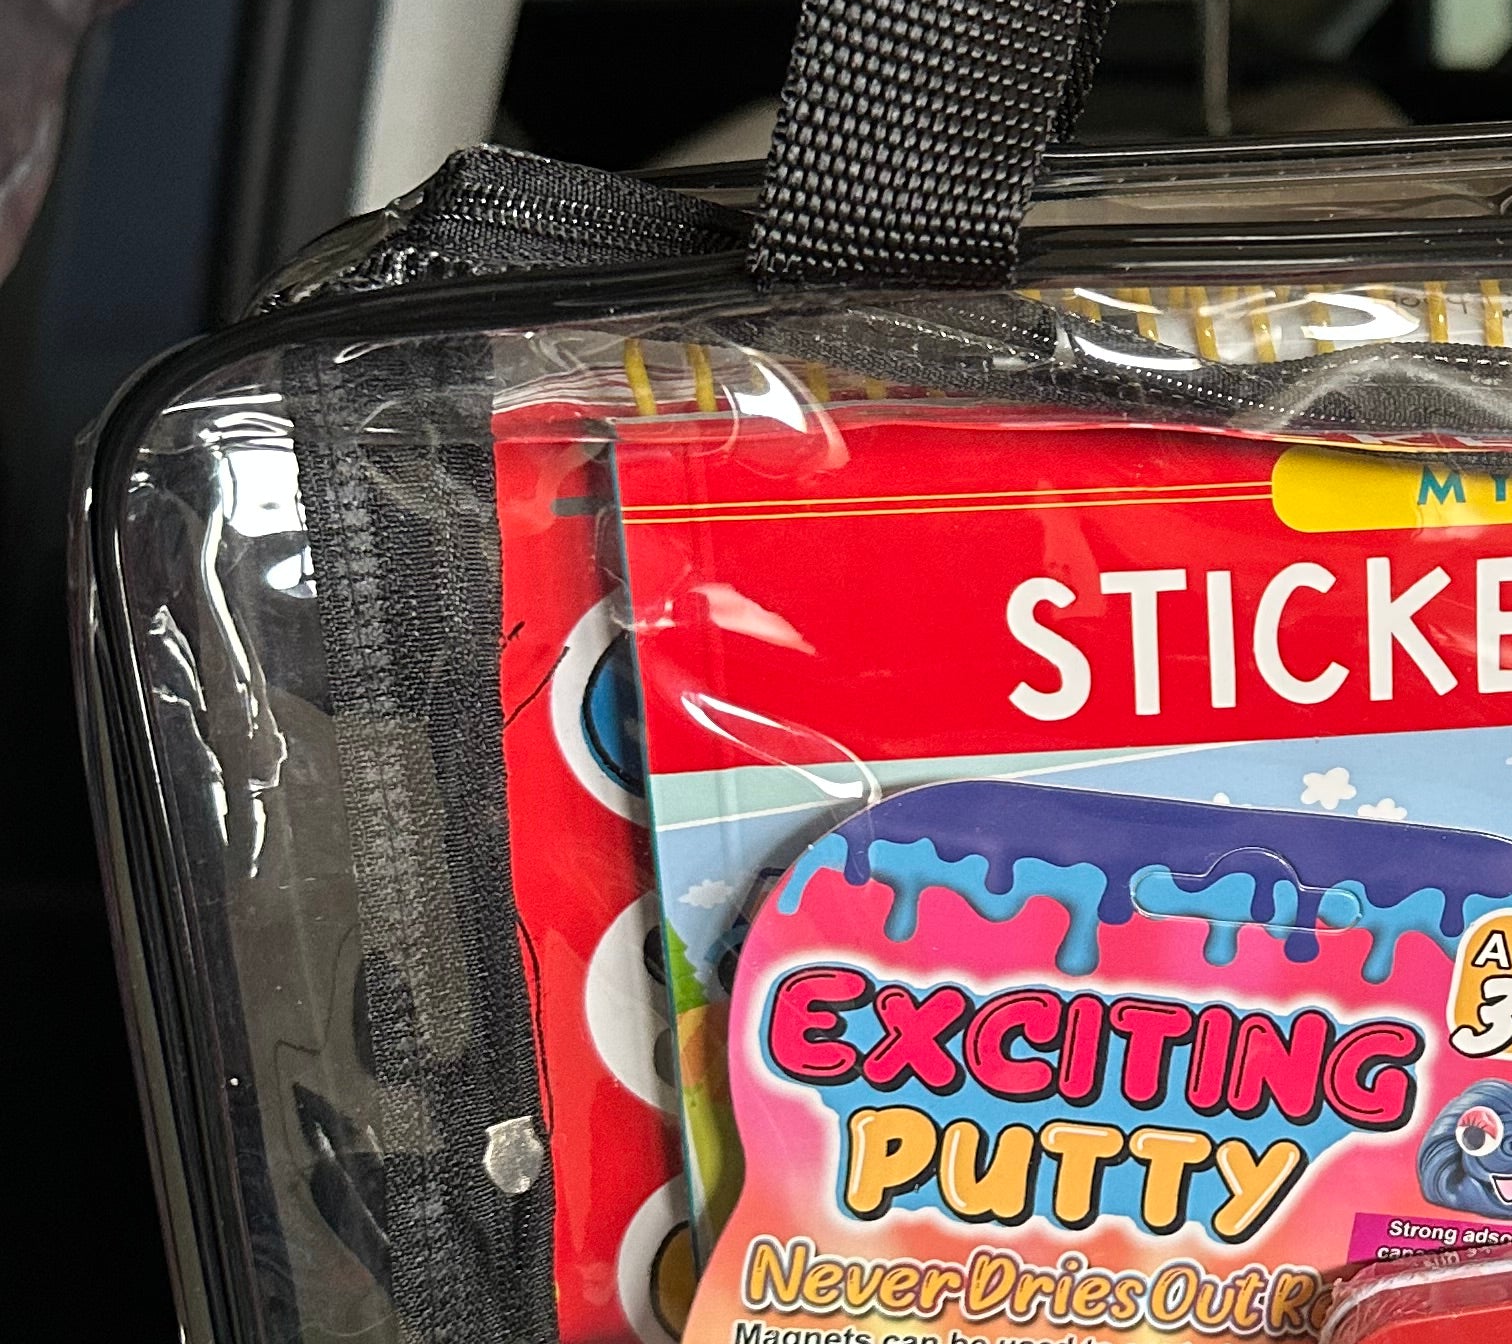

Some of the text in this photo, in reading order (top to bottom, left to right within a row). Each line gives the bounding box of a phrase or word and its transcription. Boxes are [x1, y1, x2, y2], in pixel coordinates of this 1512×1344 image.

[770, 964, 1424, 1134] EXCITING
[845, 1106, 1309, 1245] PUTTY
[1388, 1218, 1458, 1246] Strong
[745, 1238, 964, 1312] Never
[964, 1254, 1147, 1324] Dries
[1151, 1265, 1266, 1329] Out
